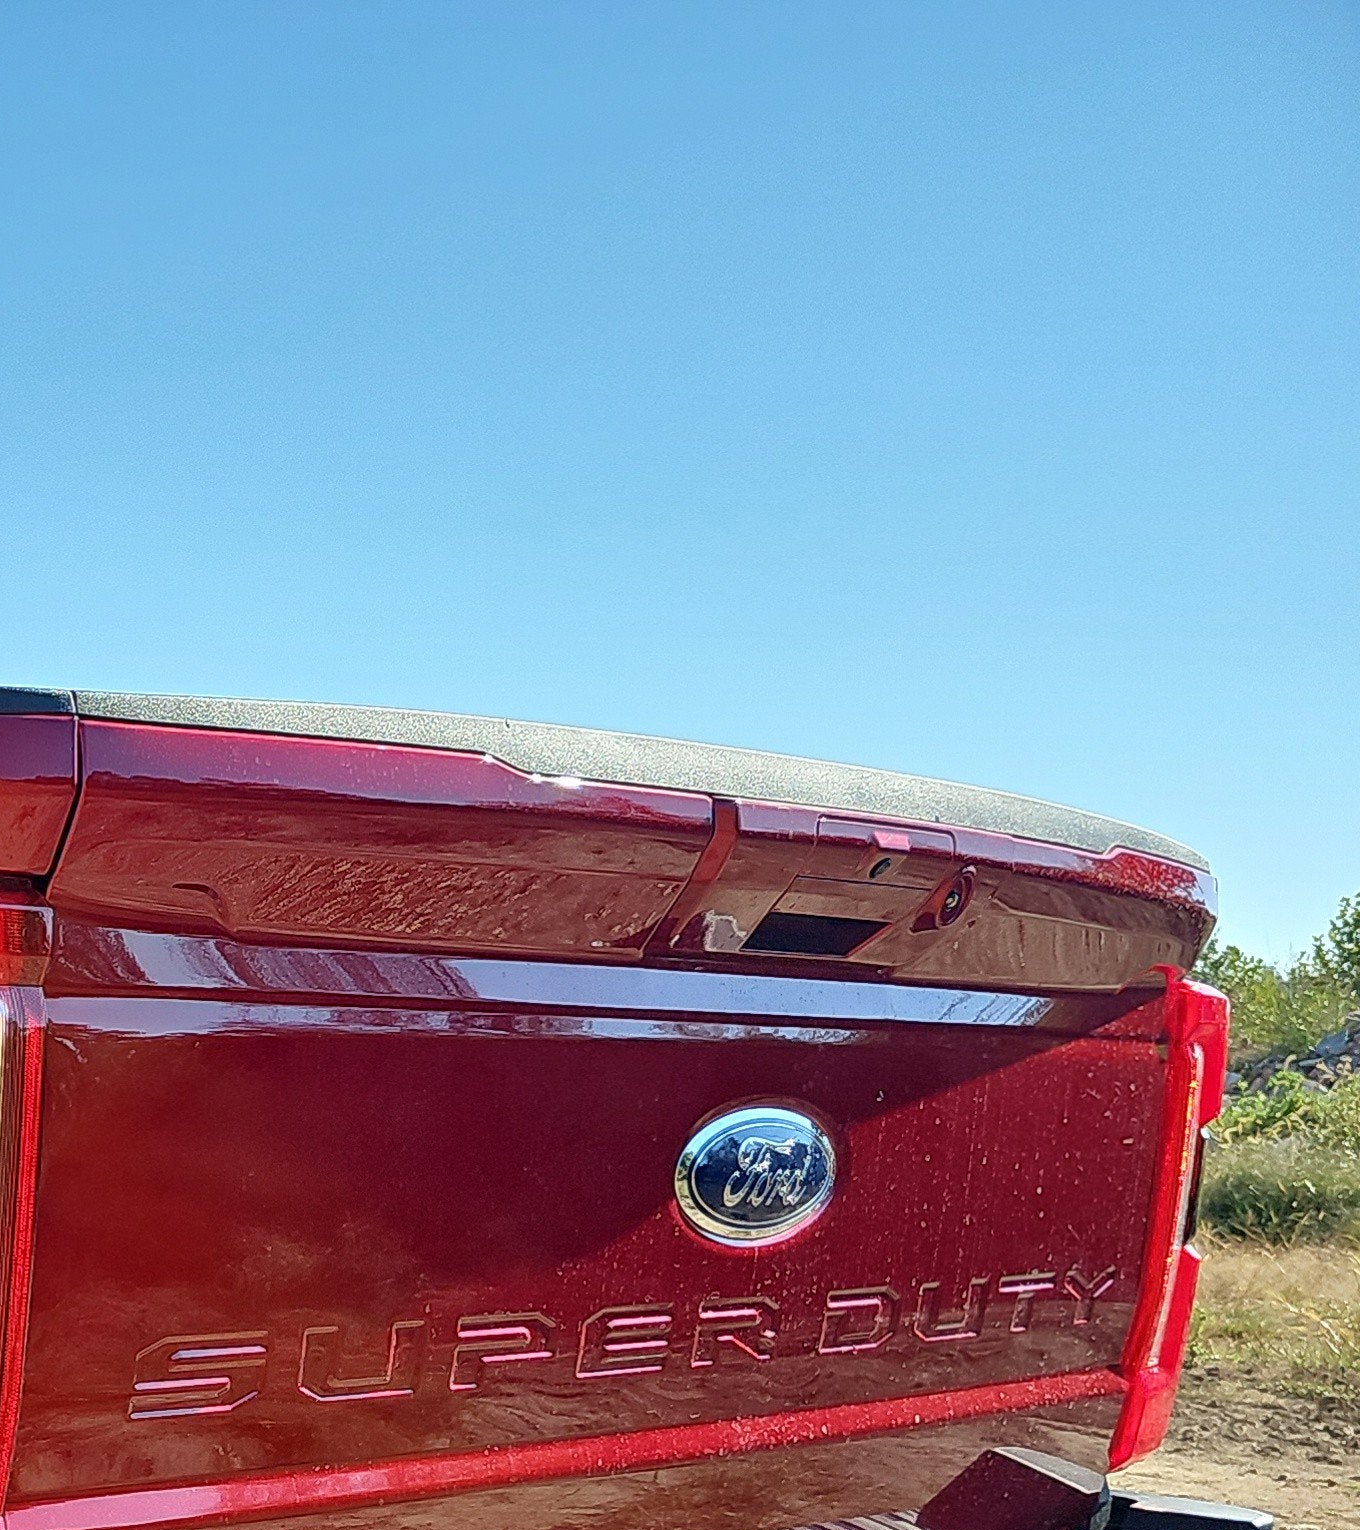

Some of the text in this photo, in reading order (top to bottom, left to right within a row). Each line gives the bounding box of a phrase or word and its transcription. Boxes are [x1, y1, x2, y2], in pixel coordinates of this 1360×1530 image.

[722, 1136, 813, 1208] Ford
[129, 1263, 1117, 1420] SUPER DUTY
